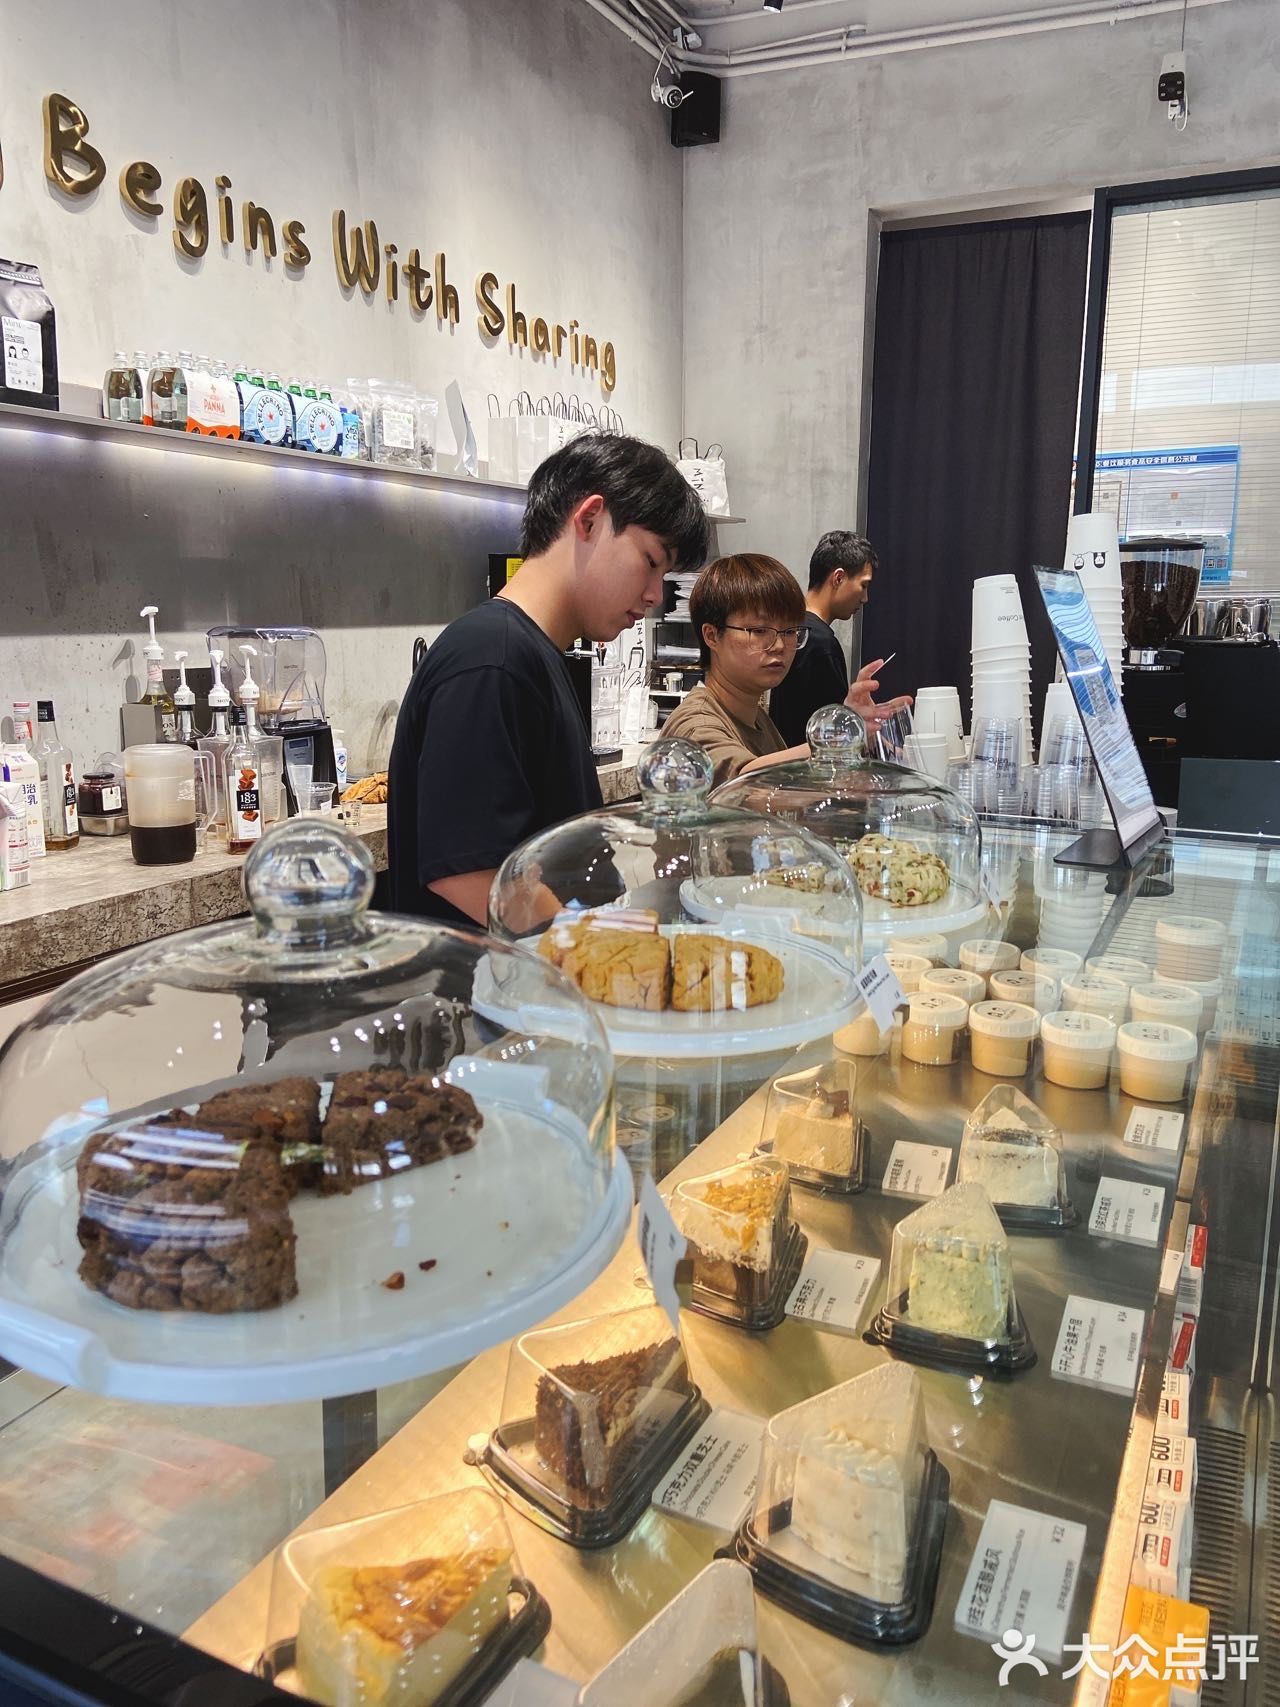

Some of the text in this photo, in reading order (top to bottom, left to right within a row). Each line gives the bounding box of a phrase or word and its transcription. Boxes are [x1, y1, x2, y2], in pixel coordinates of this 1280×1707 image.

[43, 92, 312, 267] Begins
[332, 208, 460, 325] With
[475, 271, 616, 392] Sharing
[661, 1434, 718, 1506] 巧克力双重芝士
